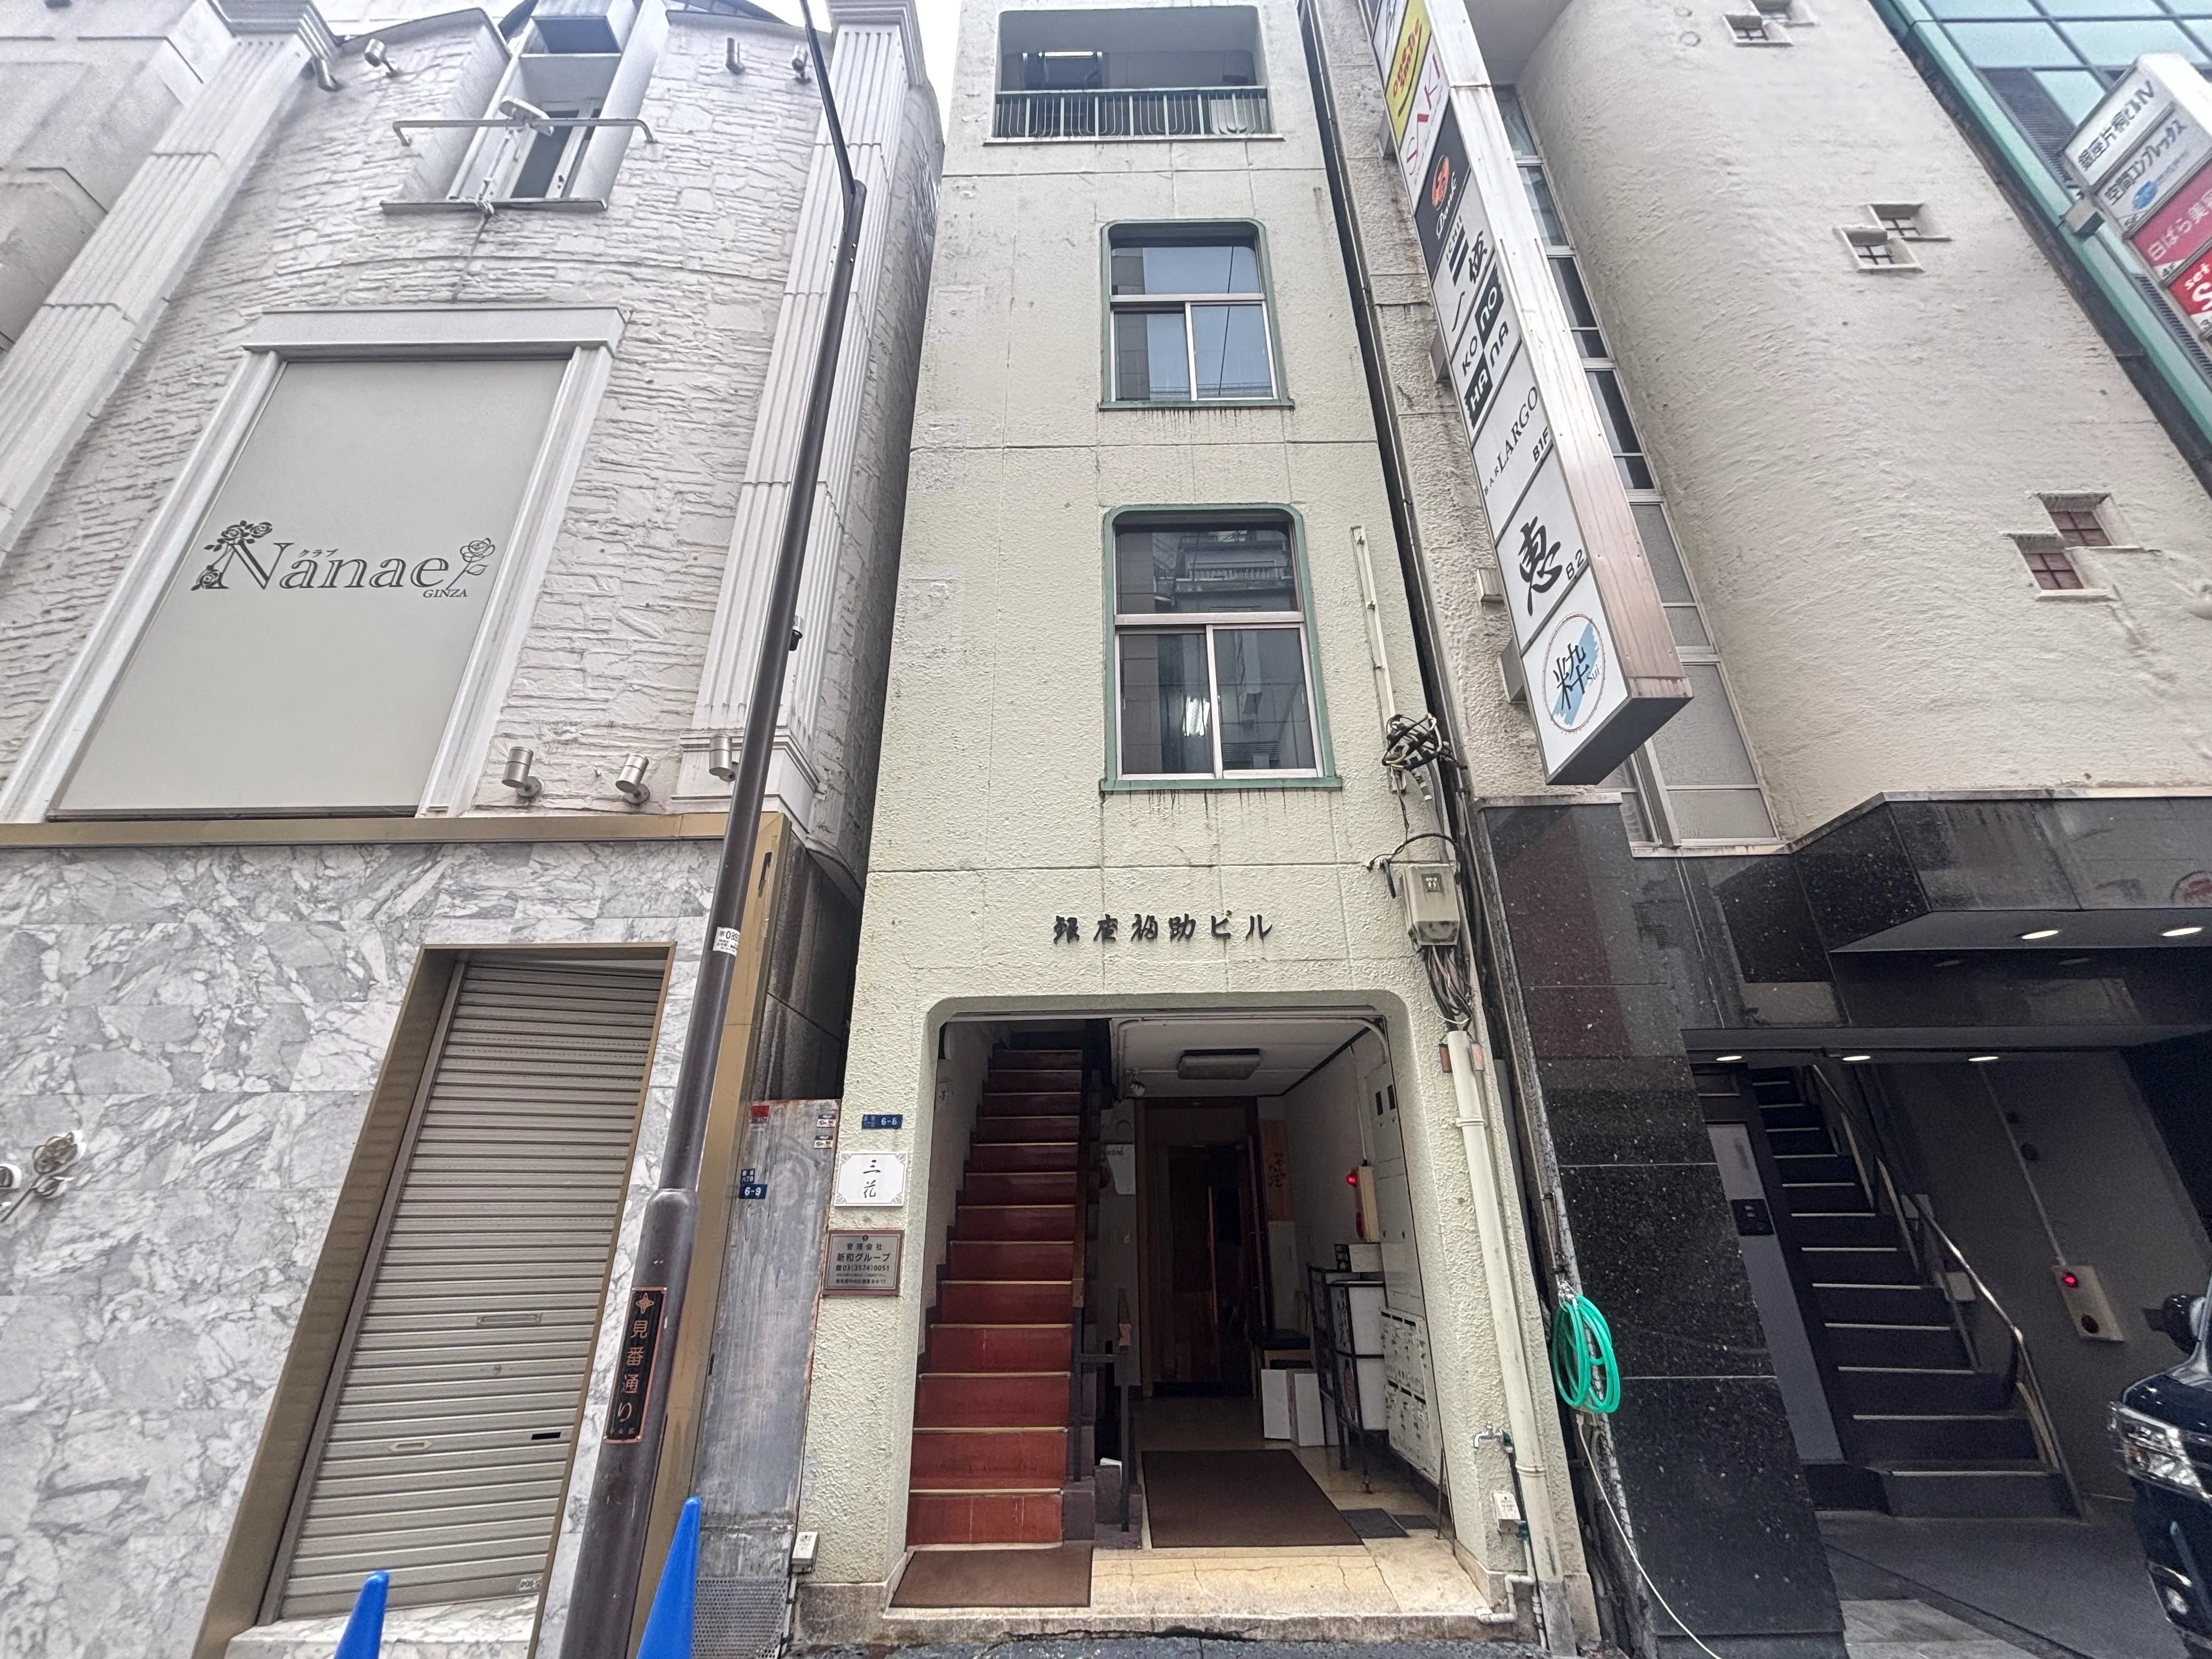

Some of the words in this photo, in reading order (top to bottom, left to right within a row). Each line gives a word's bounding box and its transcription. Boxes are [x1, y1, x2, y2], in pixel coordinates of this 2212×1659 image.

[1407, 53, 1441, 176] SAKI
[1484, 466, 1499, 496] BAR
[1497, 386, 1538, 473] LARGO
[1532, 426, 1549, 463] B1F
[205, 541, 449, 590] Nanae
[298, 549, 339, 558] クラブ
[1566, 549, 1584, 580] B2
[422, 589, 467, 598] GINZA
[744, 1187, 761, 1196] 6-9
[617, 1319, 648, 1423] 見番通り
